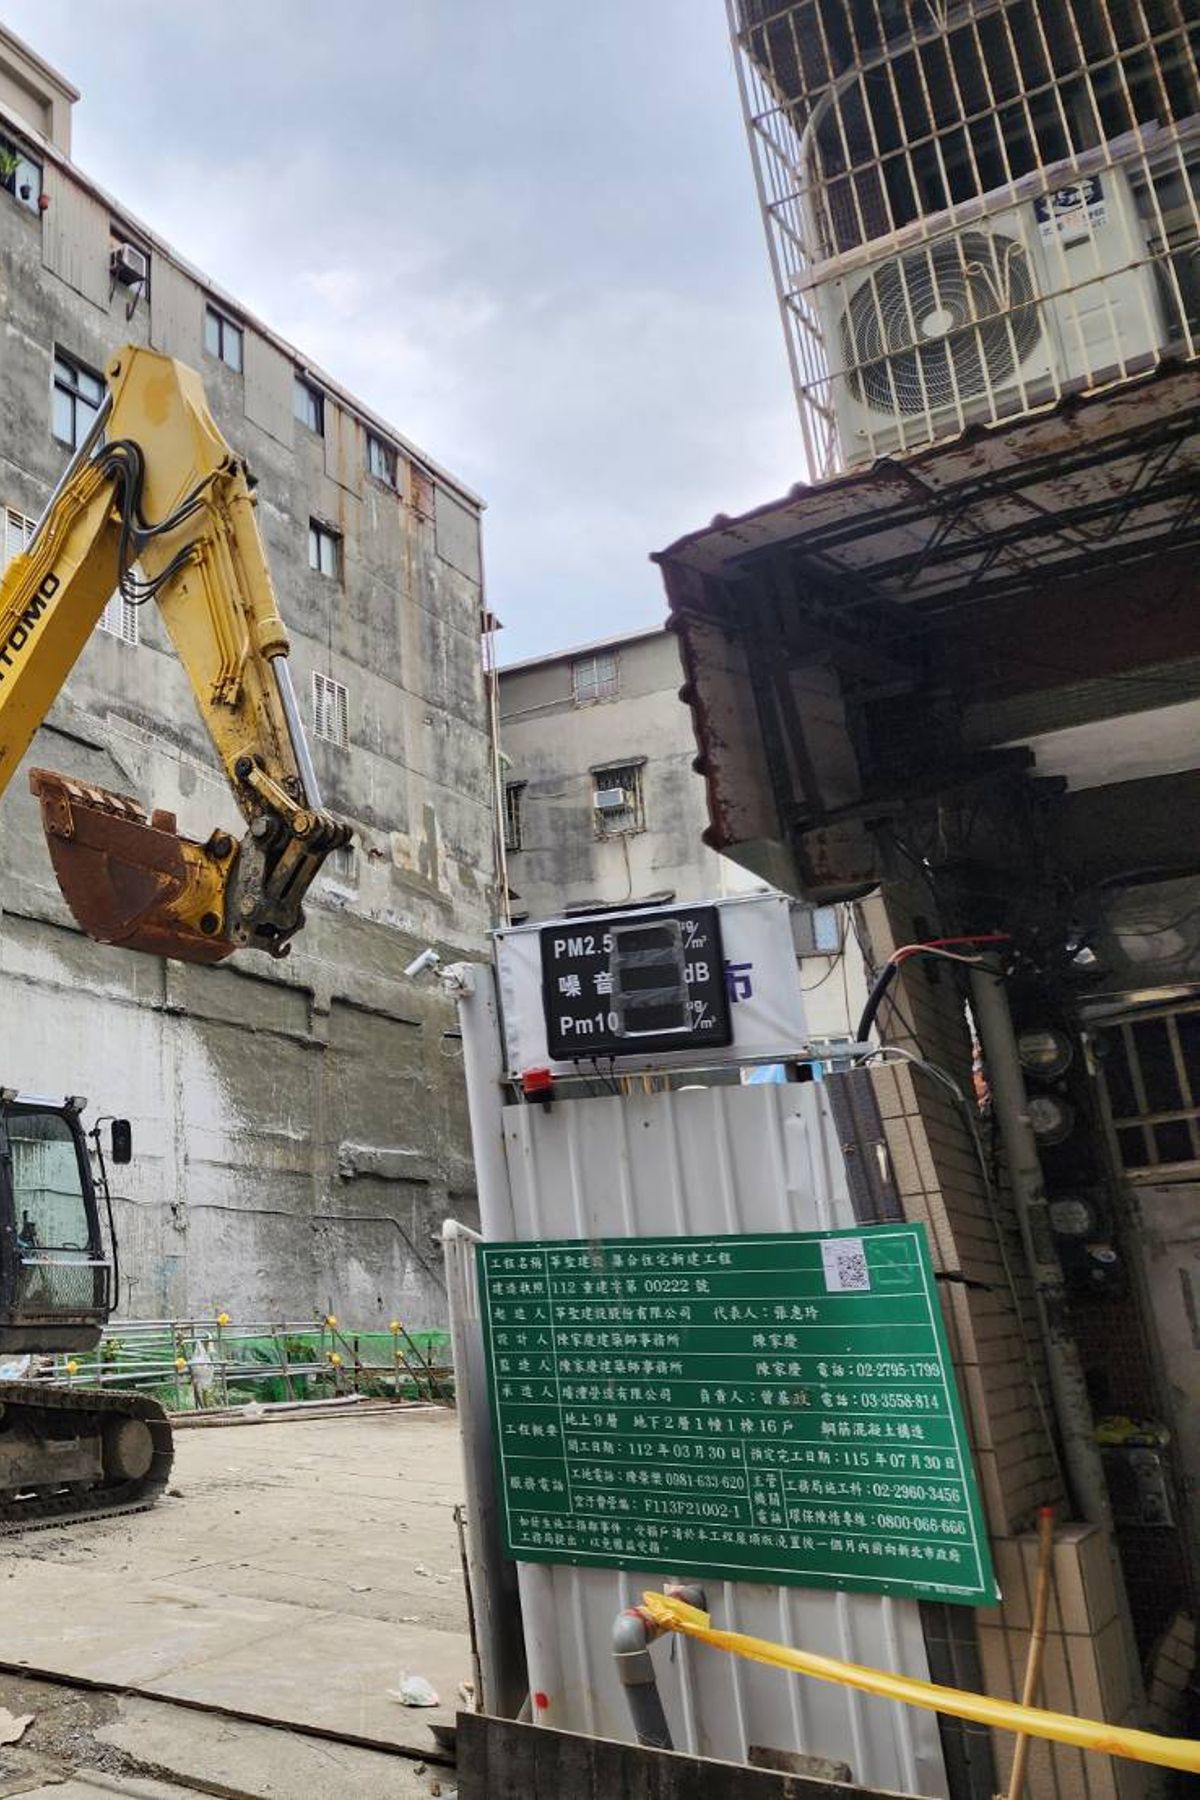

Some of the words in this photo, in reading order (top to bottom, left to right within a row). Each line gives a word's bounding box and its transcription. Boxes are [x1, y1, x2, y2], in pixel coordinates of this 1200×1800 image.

[554, 934, 614, 959] PM2.5
[683, 961, 710, 983] dB
[560, 1011, 619, 1036] Pm10
